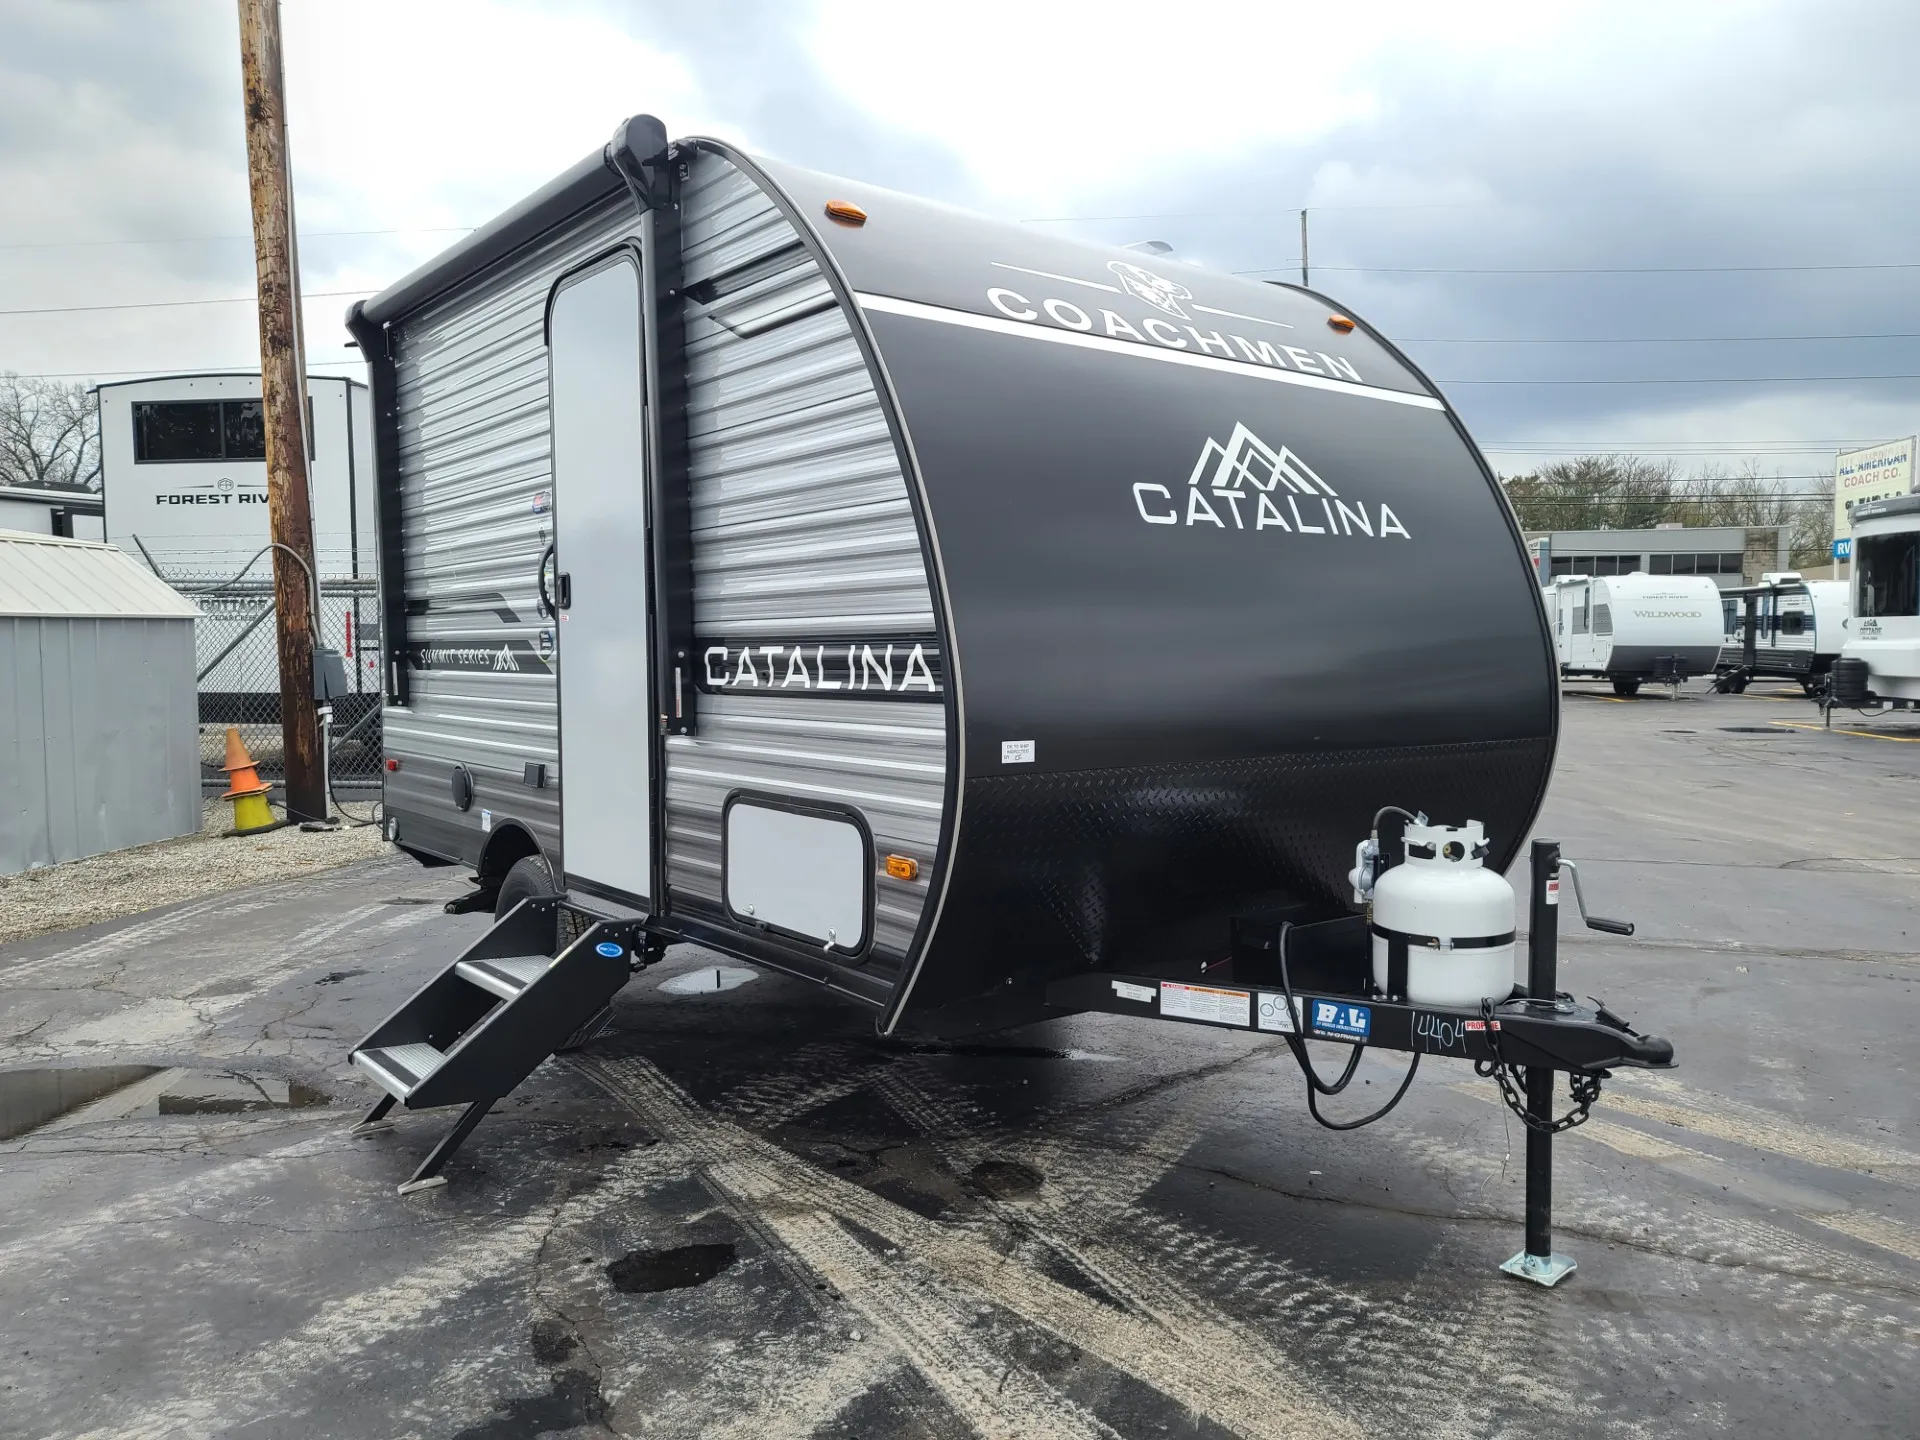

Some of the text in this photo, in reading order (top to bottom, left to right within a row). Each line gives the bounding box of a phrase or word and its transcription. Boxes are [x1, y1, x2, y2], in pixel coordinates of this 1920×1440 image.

[986, 287, 1363, 382] COACHMEN
[1844, 467, 1902, 488] COACH CO.
[155, 493, 269, 505] FOREST RIV
[1132, 482, 1412, 539] CATALINA
[1837, 541, 1851, 555] RV
[1633, 610, 1702, 618] WILDWOOD
[420, 648, 491, 665] SUMMIT SERIES
[704, 643, 936, 692] CATALINA
[1411, 1011, 1467, 1054] 14404
[1466, 1020, 1500, 1031] PROPNE
